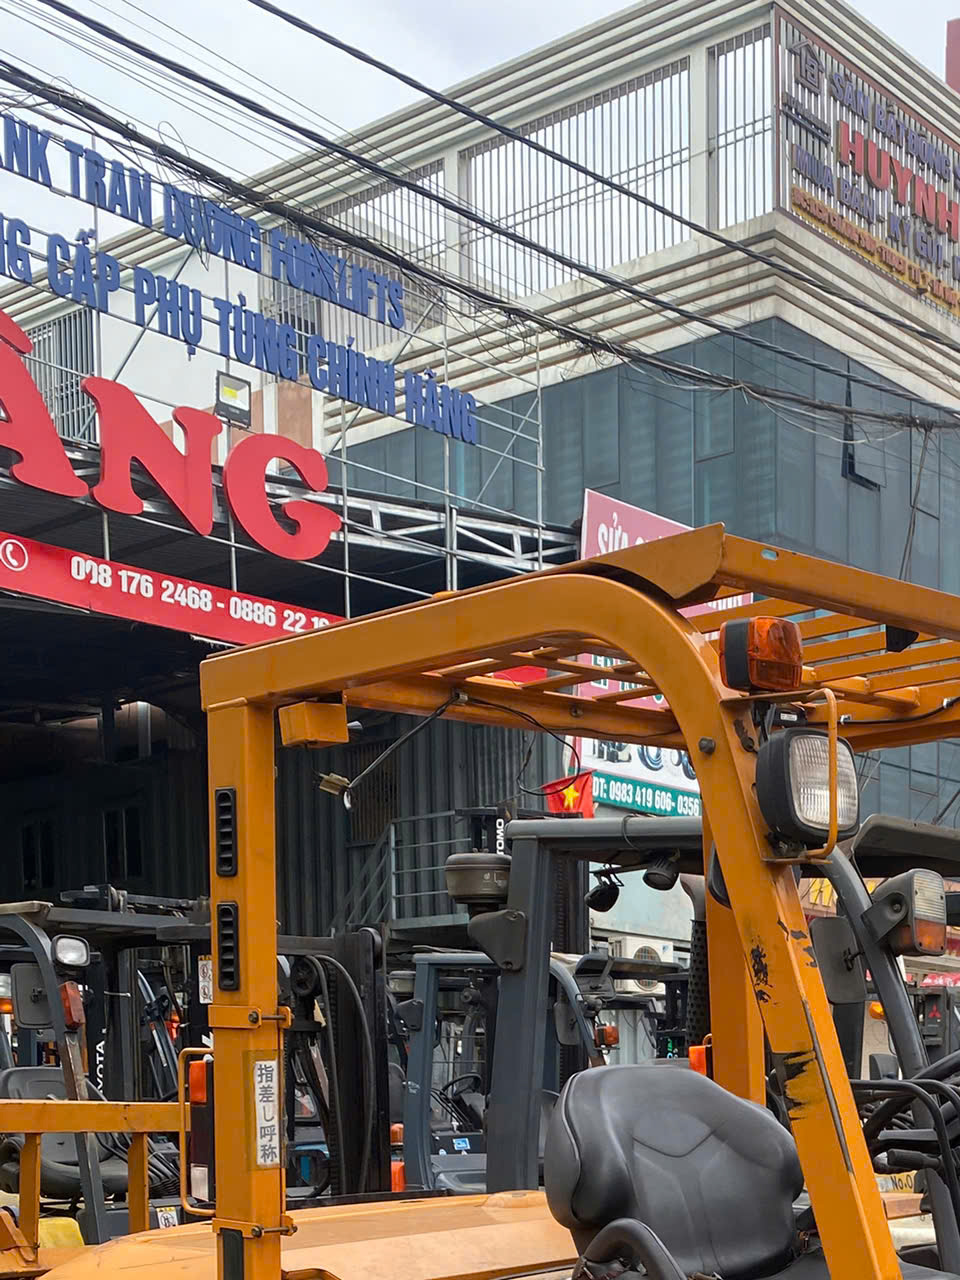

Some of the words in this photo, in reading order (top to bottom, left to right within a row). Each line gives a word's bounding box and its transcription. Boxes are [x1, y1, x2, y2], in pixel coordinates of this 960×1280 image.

[0, 113, 52, 189] NK
[48, 228, 120, 313] CẤP
[134, 264, 202, 361] PHỤ
[117, 569, 154, 598] 176
[160, 579, 212, 613] 2468
[229, 596, 276, 627] 0886
[283, 609, 307, 634] 22
[609, 780, 633, 804] 0983
[635, 785, 653, 809] 419
[677, 795, 700, 817] 0356
[256, 1063, 279, 1164] 指差し呼称
